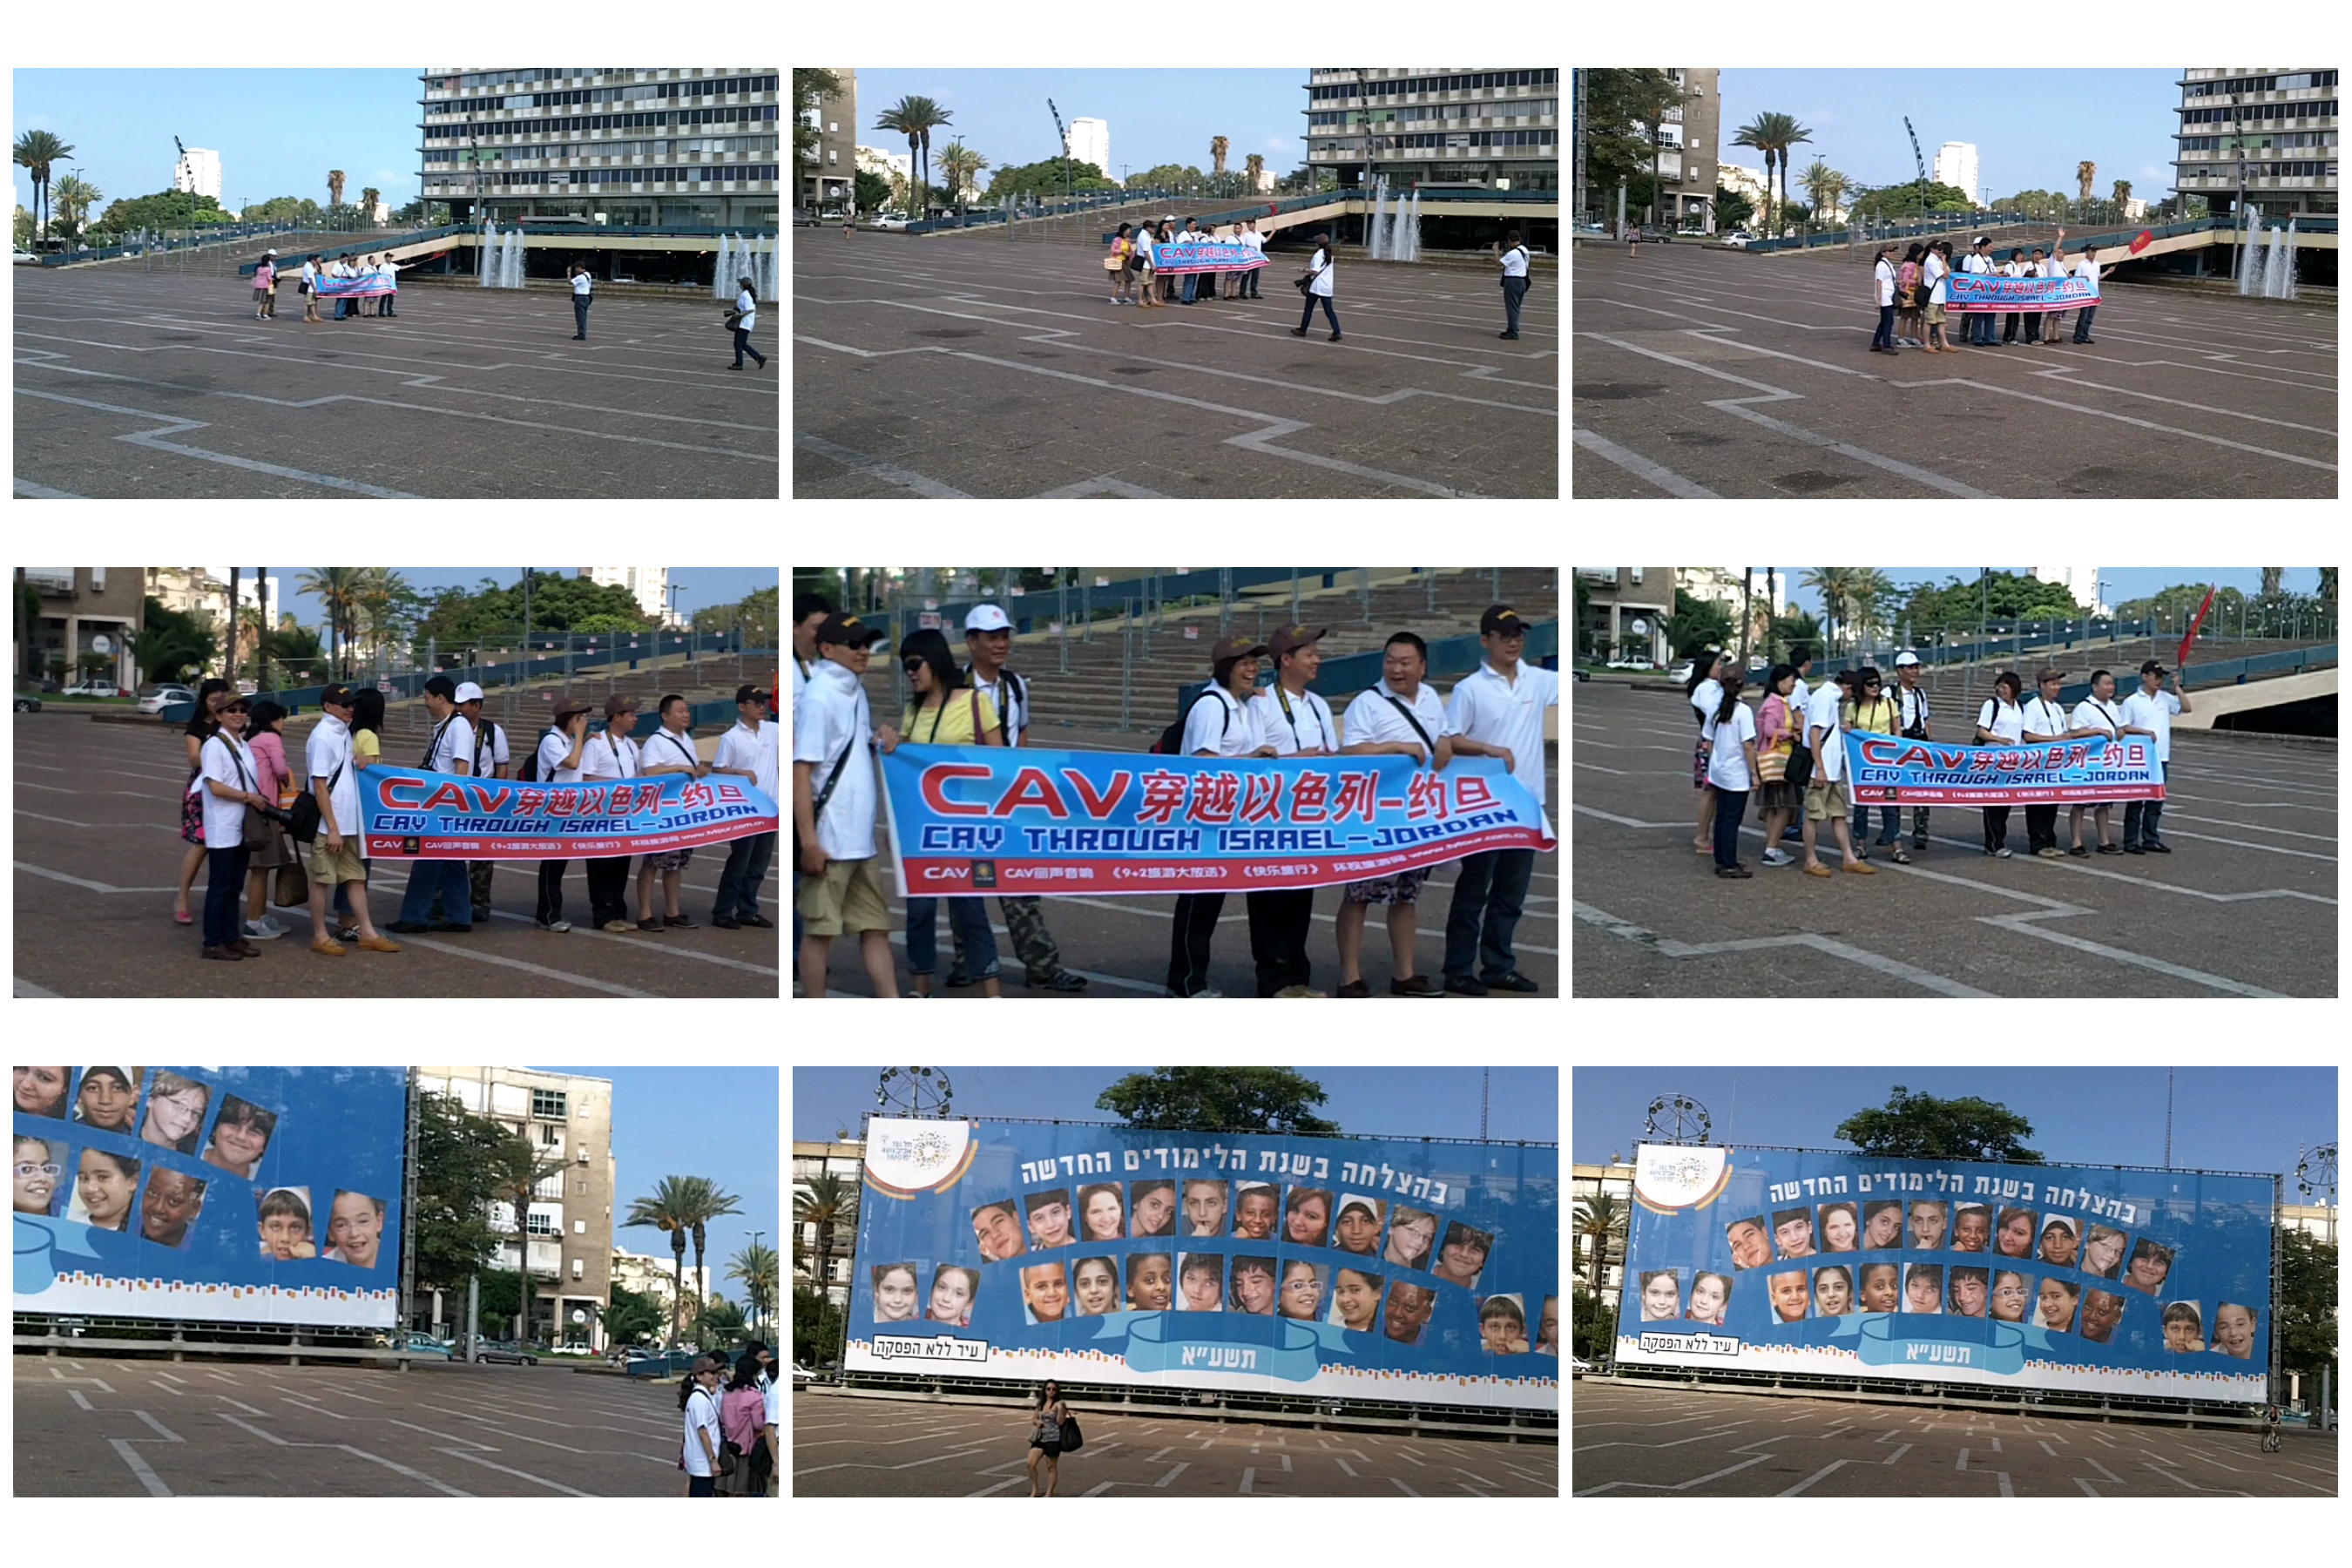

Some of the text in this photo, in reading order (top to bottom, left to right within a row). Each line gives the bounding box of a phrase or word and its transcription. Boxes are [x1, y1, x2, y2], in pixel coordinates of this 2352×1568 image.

[1159, 247, 1196, 260] CAV
[1951, 277, 2001, 293] CAV
[1862, 738, 2146, 771] CAV 穿越以色列-约旦
[1861, 768, 1901, 782] CAV
[1910, 771, 1998, 785] THROUGH
[379, 777, 748, 817] CAV 穿越以色列-约旦
[920, 761, 1502, 825] CAV 穿越以色列-约旦
[373, 814, 427, 831] CAV
[439, 816, 550, 833] THROUGH
[921, 808, 1518, 853] CAV THROUGH ISRAEL-JORDAN
[373, 840, 402, 849] CAV
[923, 867, 970, 880] CAV
[1021, 1143, 1448, 1205] בהצלחה בשנת הלימודים החדשה
[1769, 1169, 2137, 1224] בהצלחה בשנת הלימודים החדשה
[876, 1341, 978, 1357] עיר ללא הפסקה
[1643, 1336, 1731, 1352] עיר ללא הפסקה
